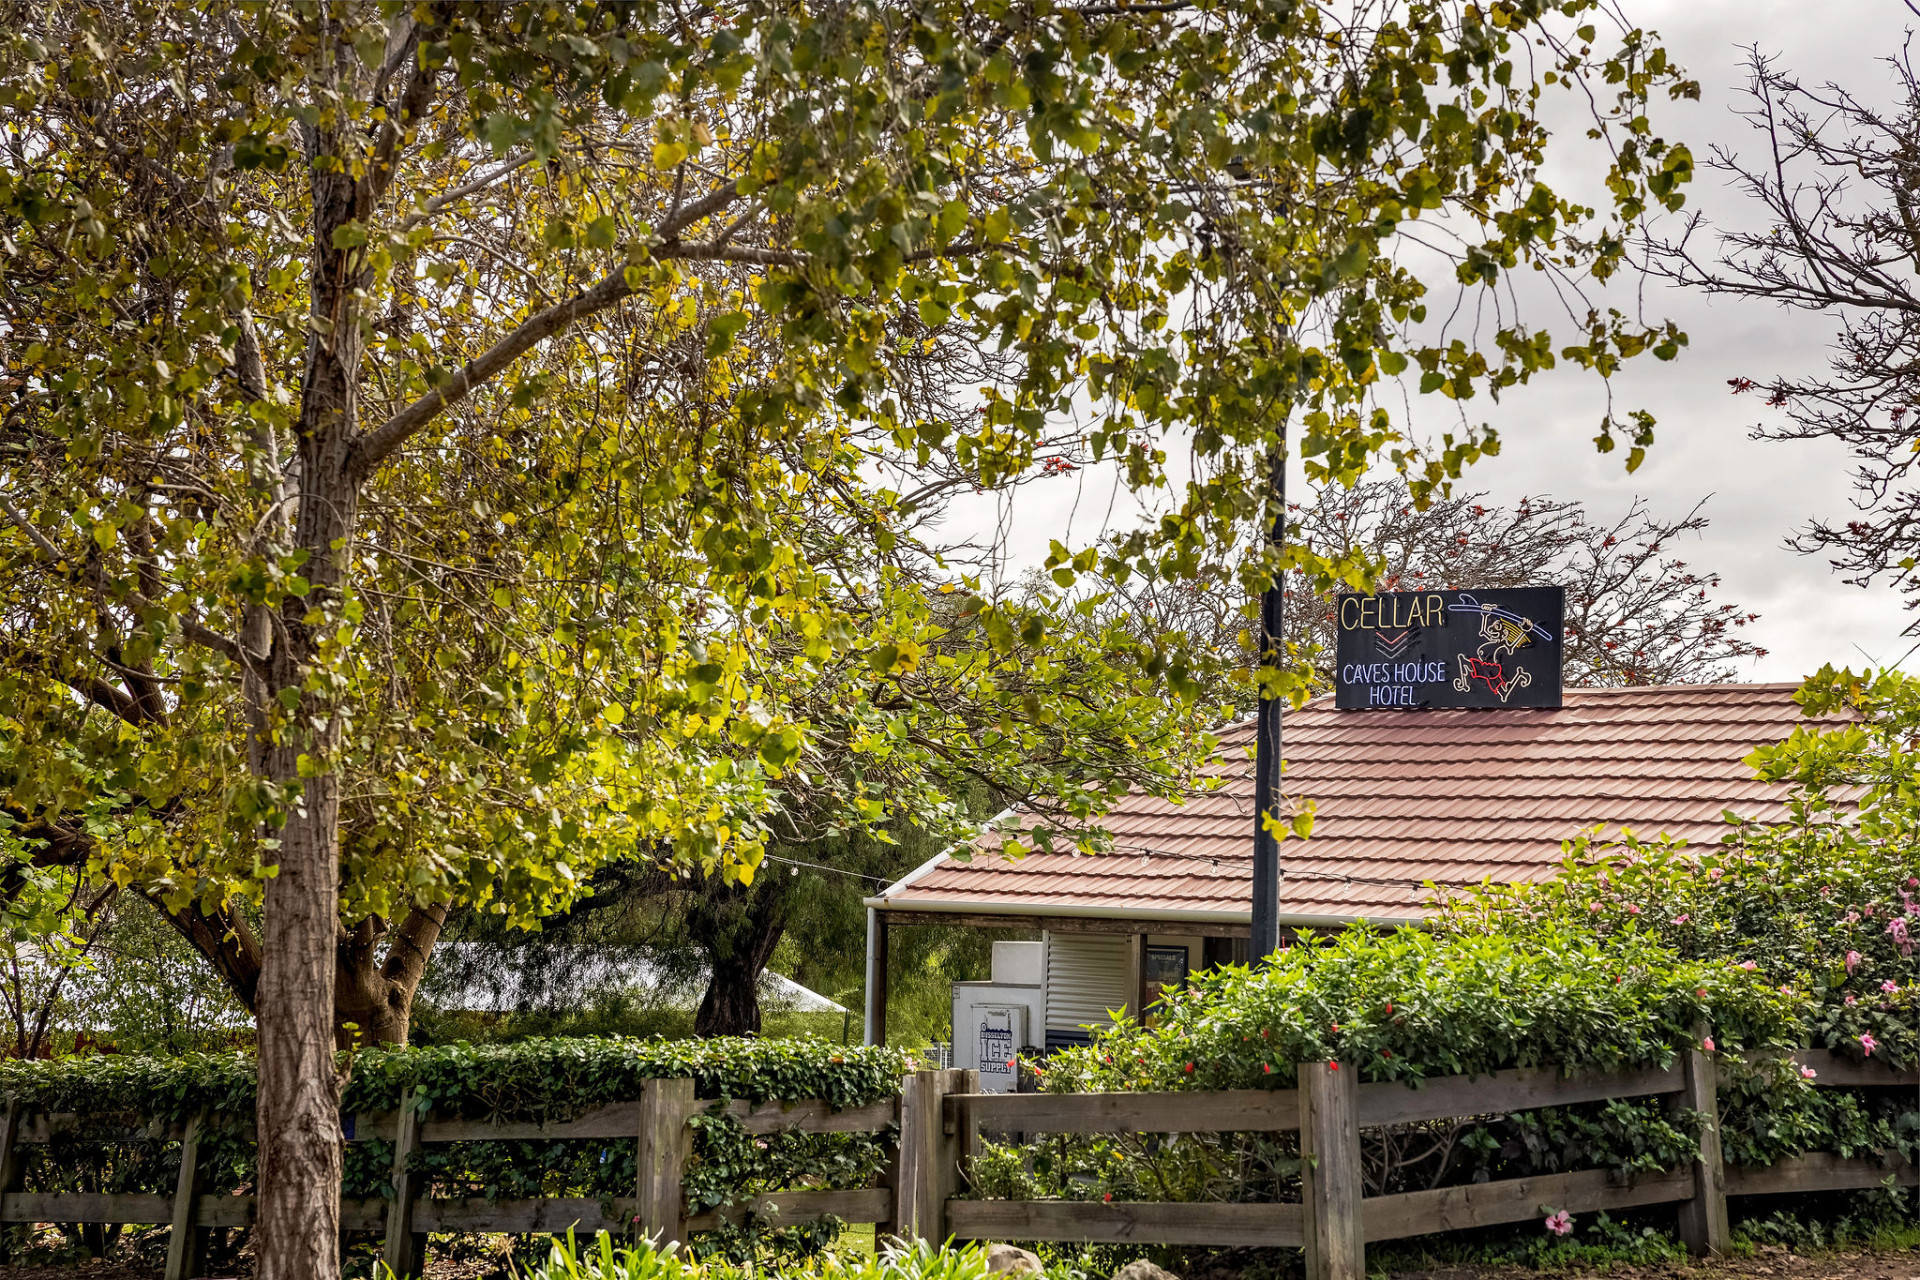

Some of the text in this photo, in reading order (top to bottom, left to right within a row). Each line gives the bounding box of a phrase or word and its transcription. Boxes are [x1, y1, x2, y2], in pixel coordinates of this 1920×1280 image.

[1341, 595, 1444, 630] CELLAR
[1343, 662, 1446, 685] CAVES HOUSE
[1370, 685, 1417, 706] HOTEL
[980, 1039, 1012, 1061] ICE
